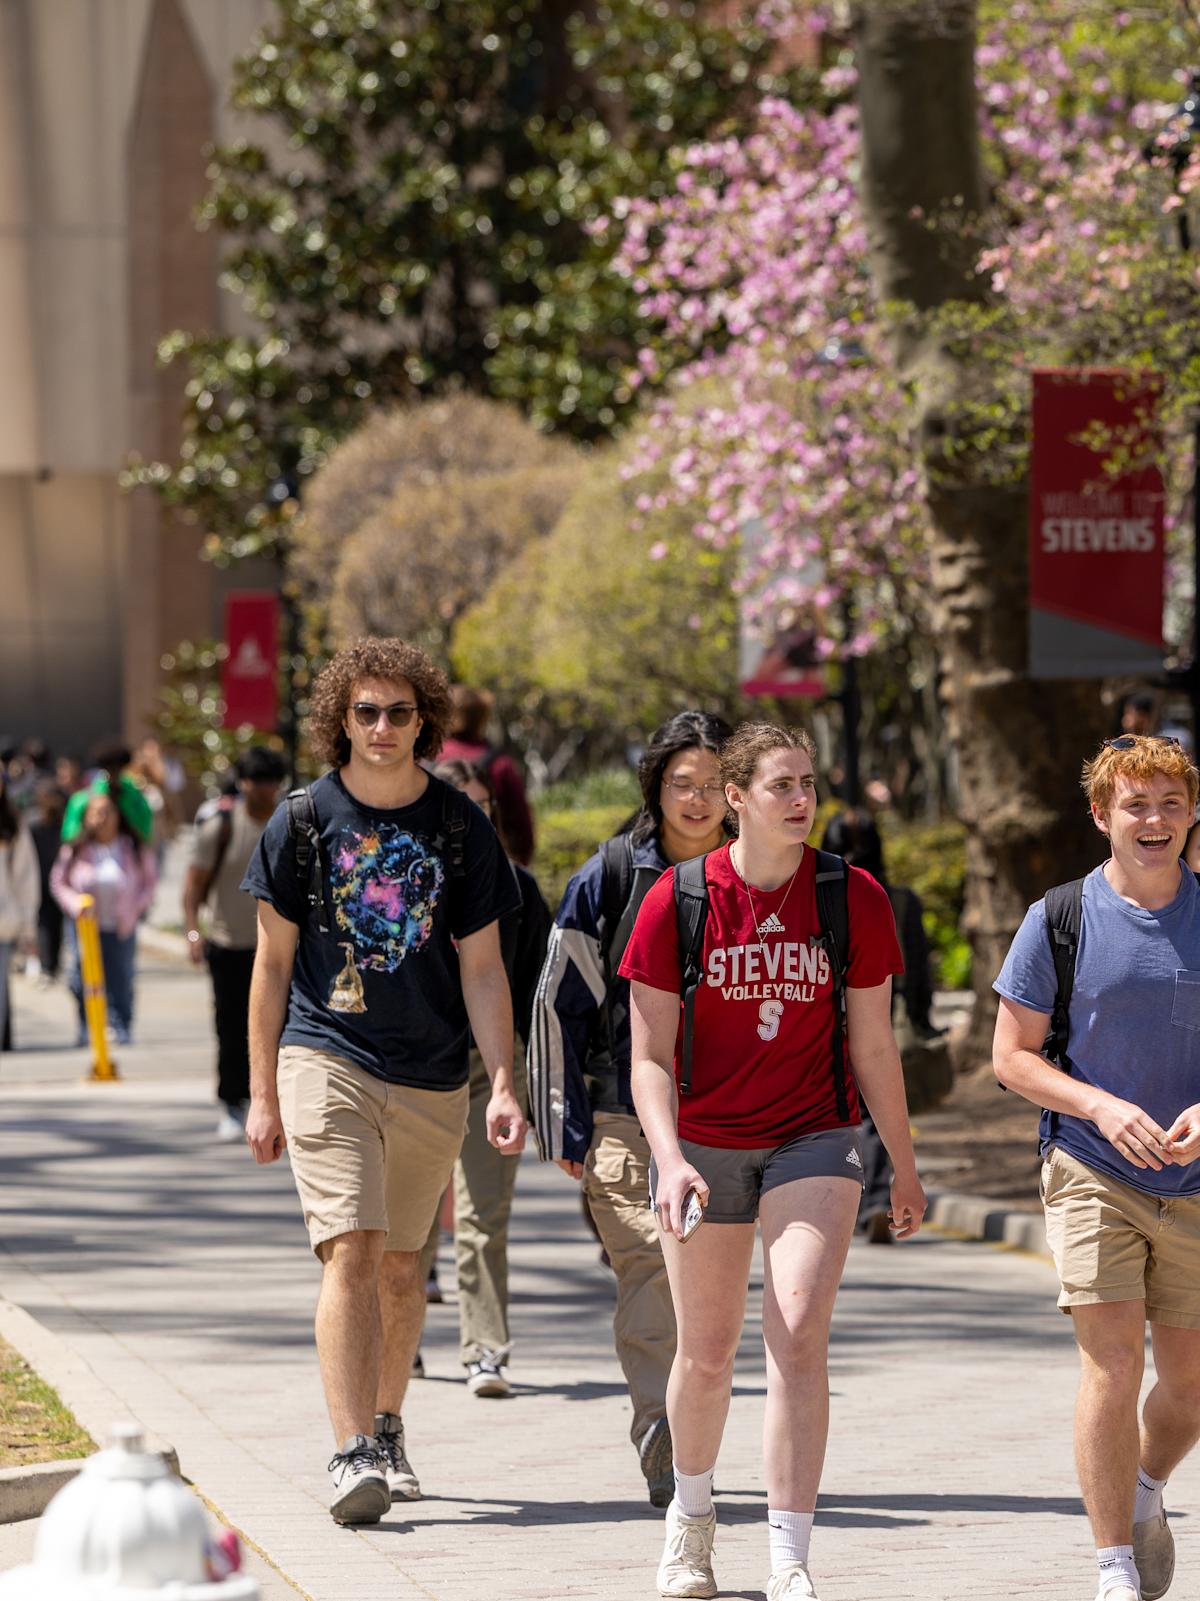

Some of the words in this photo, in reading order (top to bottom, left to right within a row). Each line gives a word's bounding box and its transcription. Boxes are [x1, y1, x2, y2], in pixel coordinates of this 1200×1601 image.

[1041, 517, 1156, 553] STEVENS
[757, 924, 785, 933] adidas
[706, 941, 829, 988] STEVENS
[721, 983, 815, 1003] VOLLEYBALL
[756, 999, 785, 1041] S
